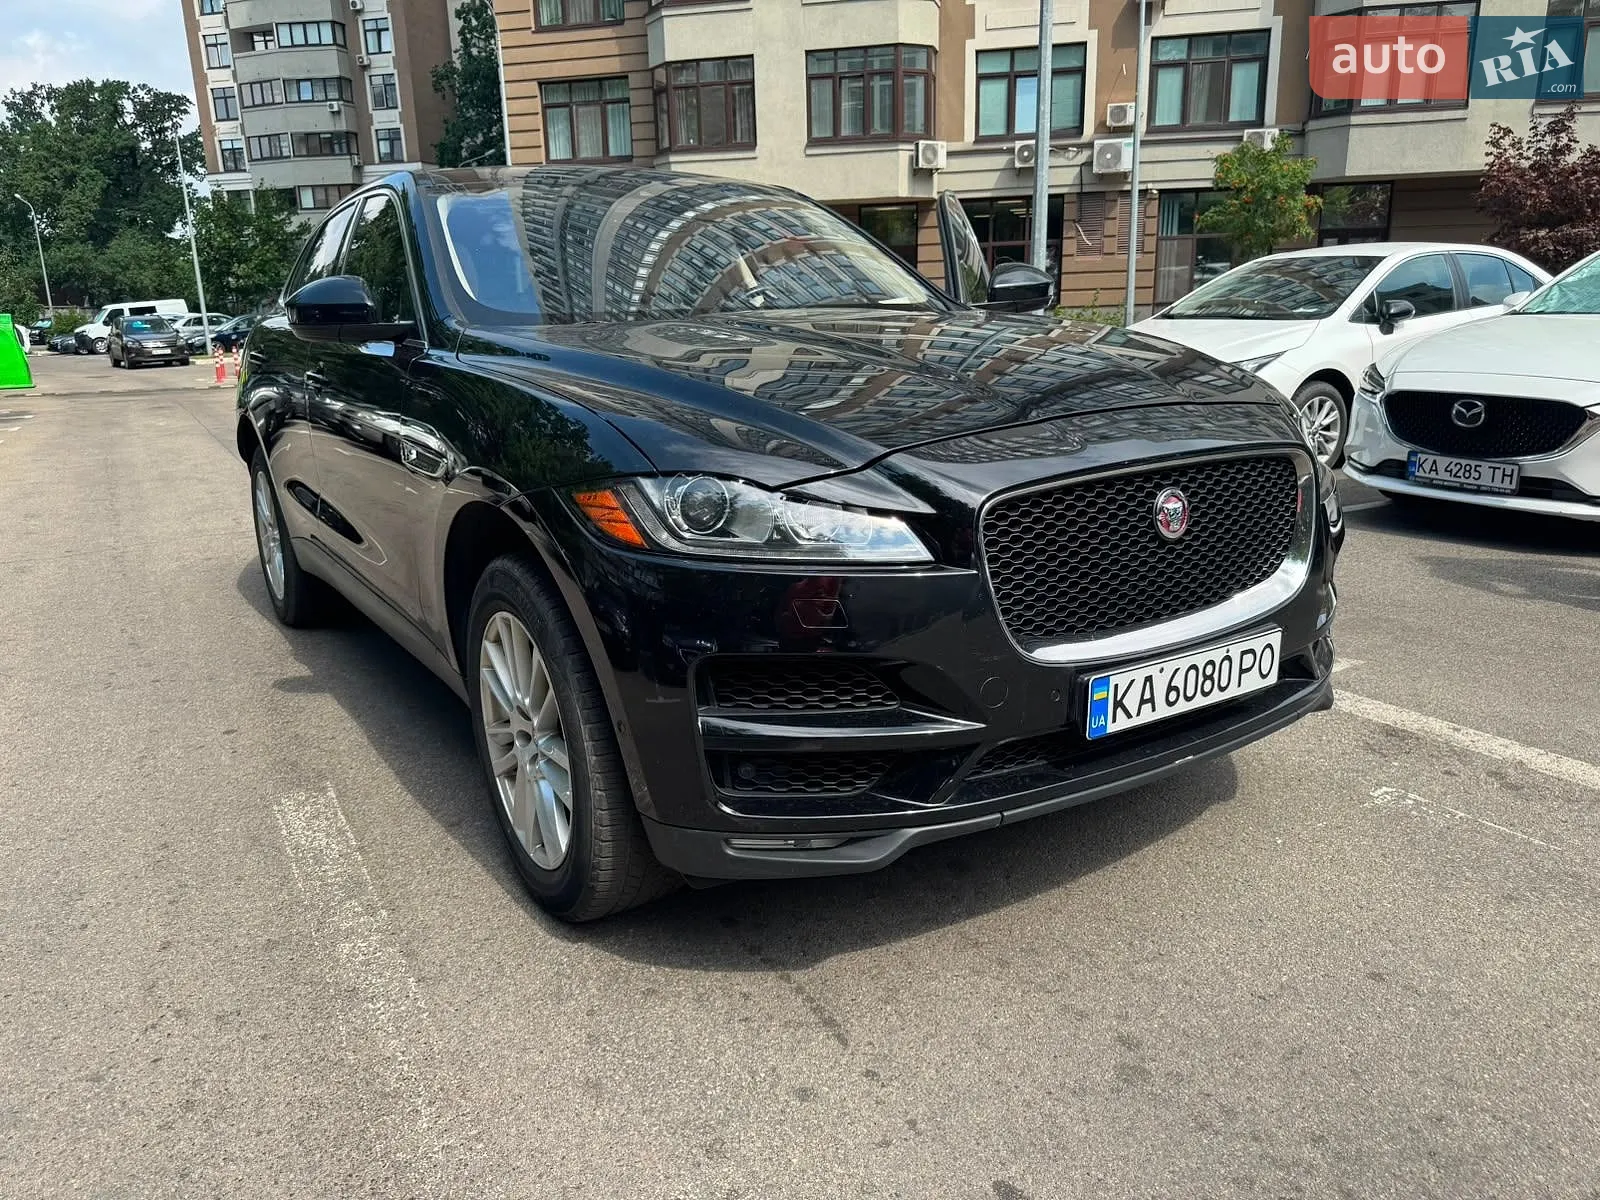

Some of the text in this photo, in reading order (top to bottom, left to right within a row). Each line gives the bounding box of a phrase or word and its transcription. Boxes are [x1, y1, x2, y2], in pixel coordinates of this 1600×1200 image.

[1416, 456, 1515, 485] KA 4285 TH
[1111, 675, 1156, 724] KA
[1091, 714, 1106, 729] UA
